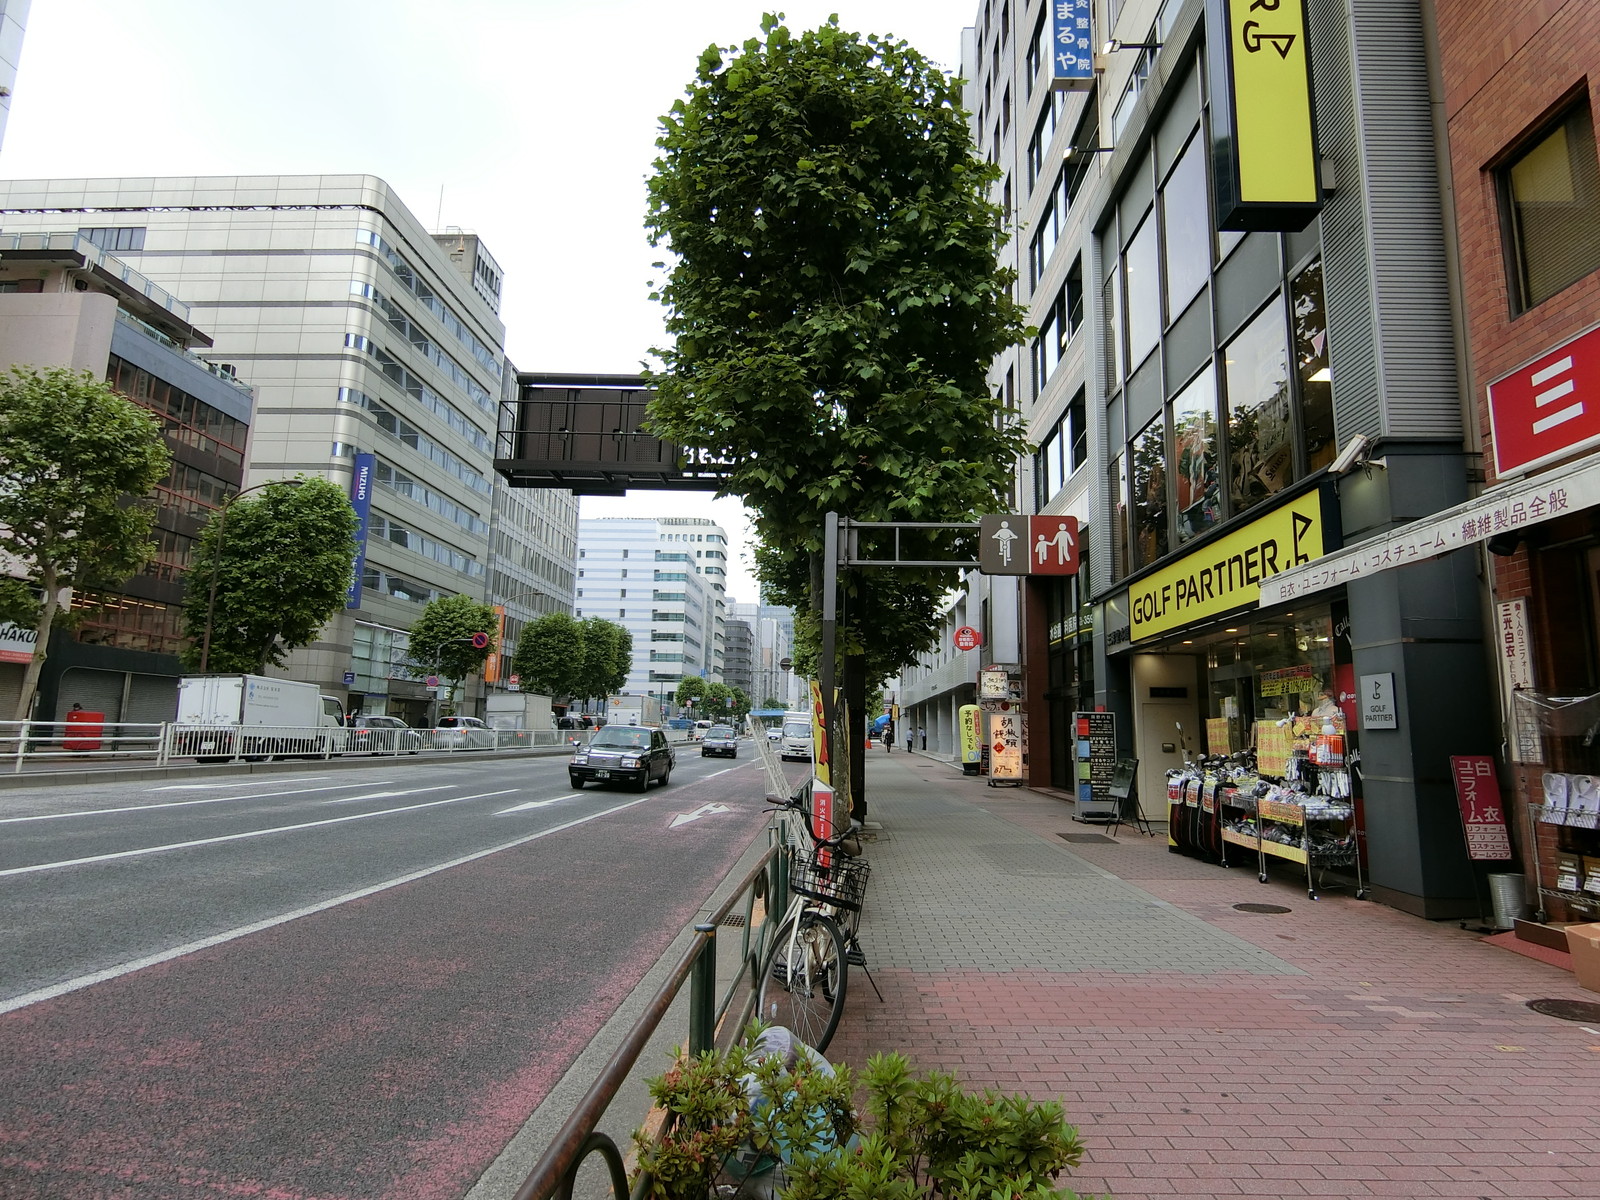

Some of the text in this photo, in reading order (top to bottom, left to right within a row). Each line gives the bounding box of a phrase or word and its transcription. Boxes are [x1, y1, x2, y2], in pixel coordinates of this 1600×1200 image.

[357, 465, 369, 501] MIZUHO
[1132, 584, 1172, 626] GOLF
[1502, 603, 1516, 658] 三光白衣
[1370, 704, 1386, 713] GOLF
[964, 709, 974, 751] 予約なしでも
[967, 750, 981, 762] OK
[1458, 760, 1484, 823] ユニフォーム
[1472, 851, 1510, 859] チームウェア
